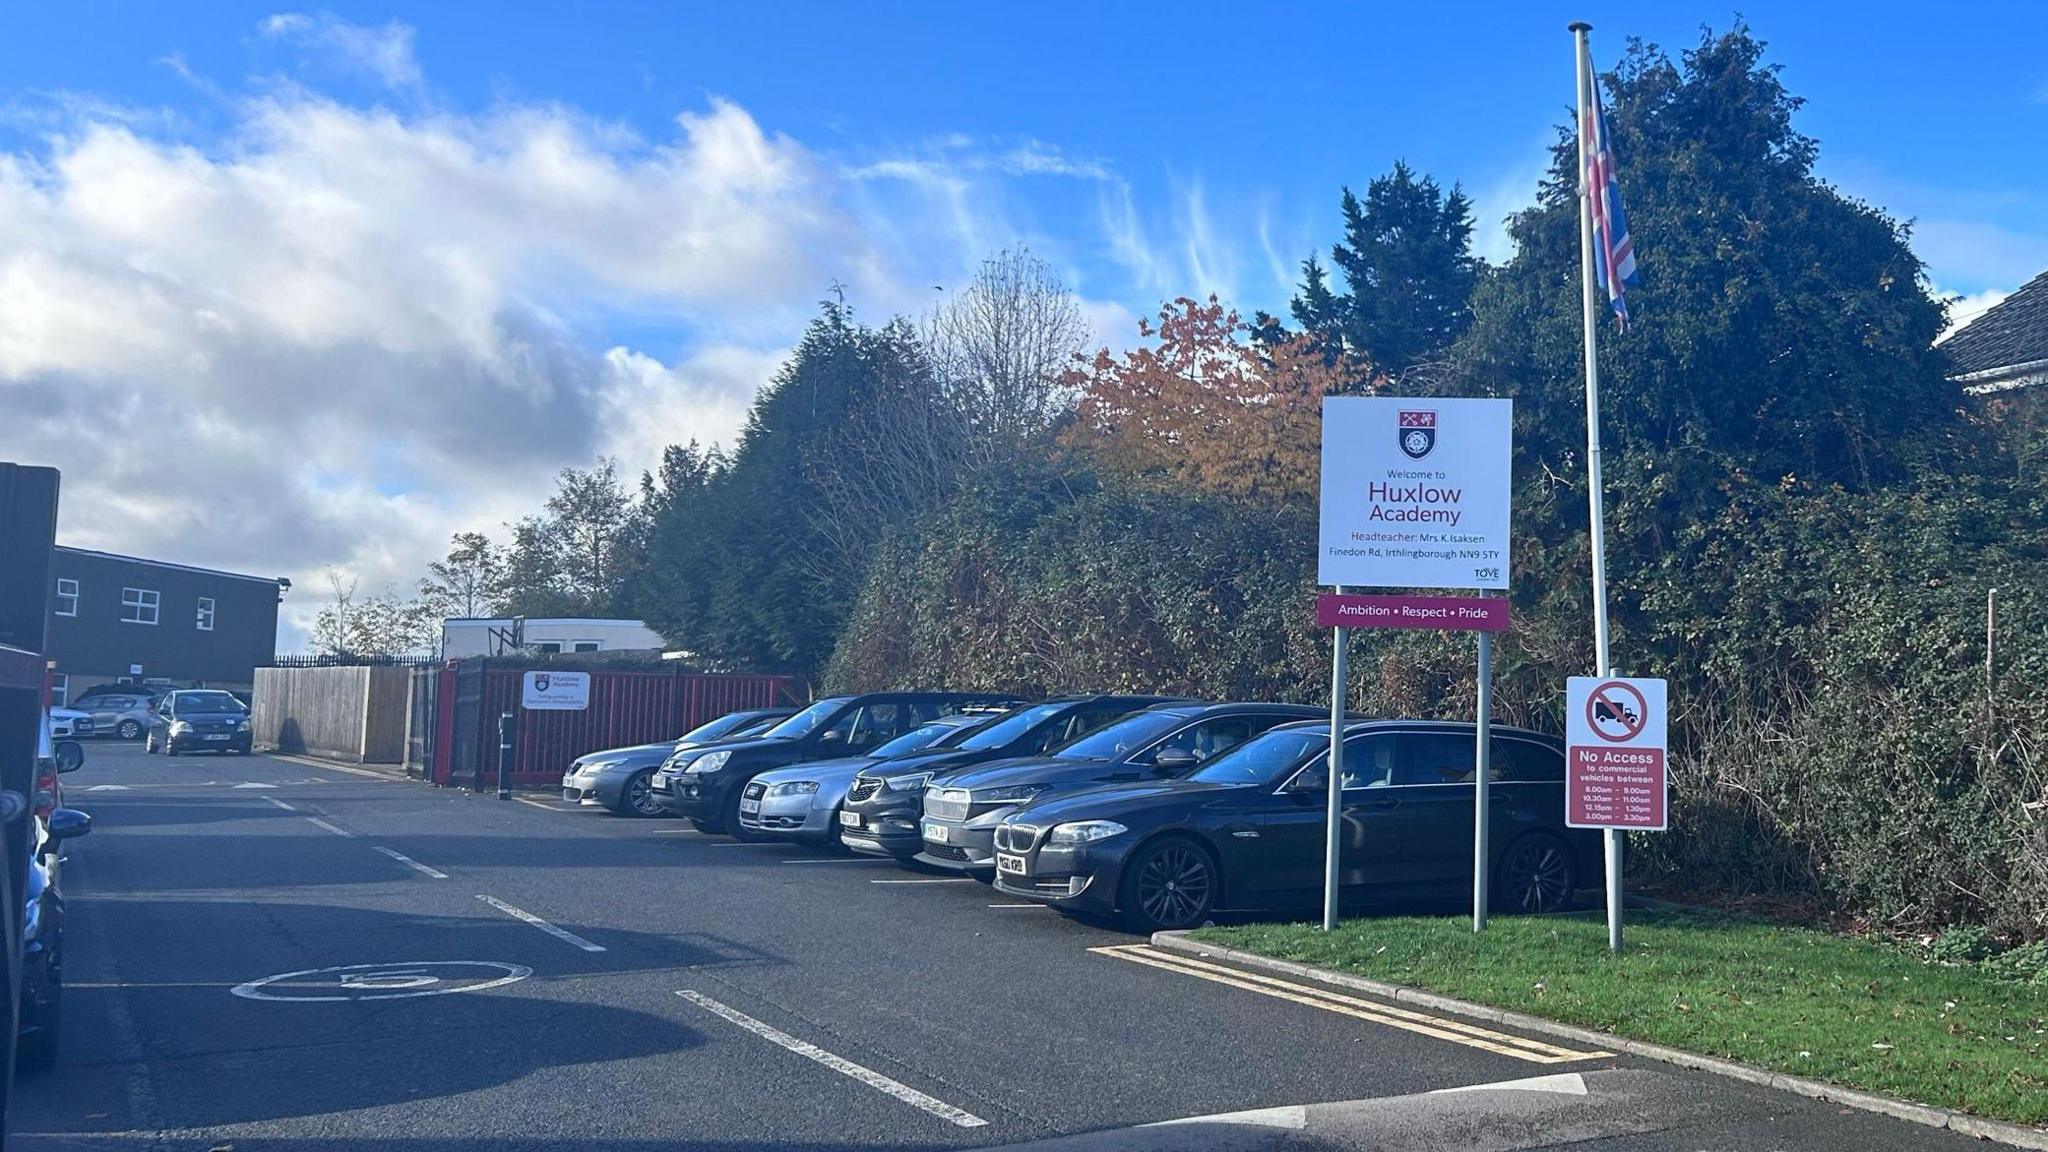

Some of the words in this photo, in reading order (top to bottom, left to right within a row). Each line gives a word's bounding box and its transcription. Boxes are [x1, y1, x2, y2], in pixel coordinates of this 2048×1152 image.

[1387, 470, 1432, 479] Welcome
[1435, 471, 1446, 480] to
[1369, 481, 1461, 503] Huxlow
[1369, 504, 1461, 527] Academy
[1351, 532, 1417, 542] Headteacher:
[1329, 547, 1366, 557] Finedon
[1368, 548, 1383, 558] Rd,
[1385, 548, 1457, 560] Irthlingborough
[1459, 550, 1480, 559] NN9
[1482, 550, 1499, 559] 5TY
[1474, 567, 1500, 578] TOVE
[1338, 604, 1390, 616] Ambition
[1402, 606, 1447, 619] Respect
[1458, 607, 1489, 619] Pride
[1580, 750, 1598, 763] No
[1603, 751, 1654, 764] Access
[1580, 774, 1614, 782] vehicles
[1617, 775, 1654, 783] between
